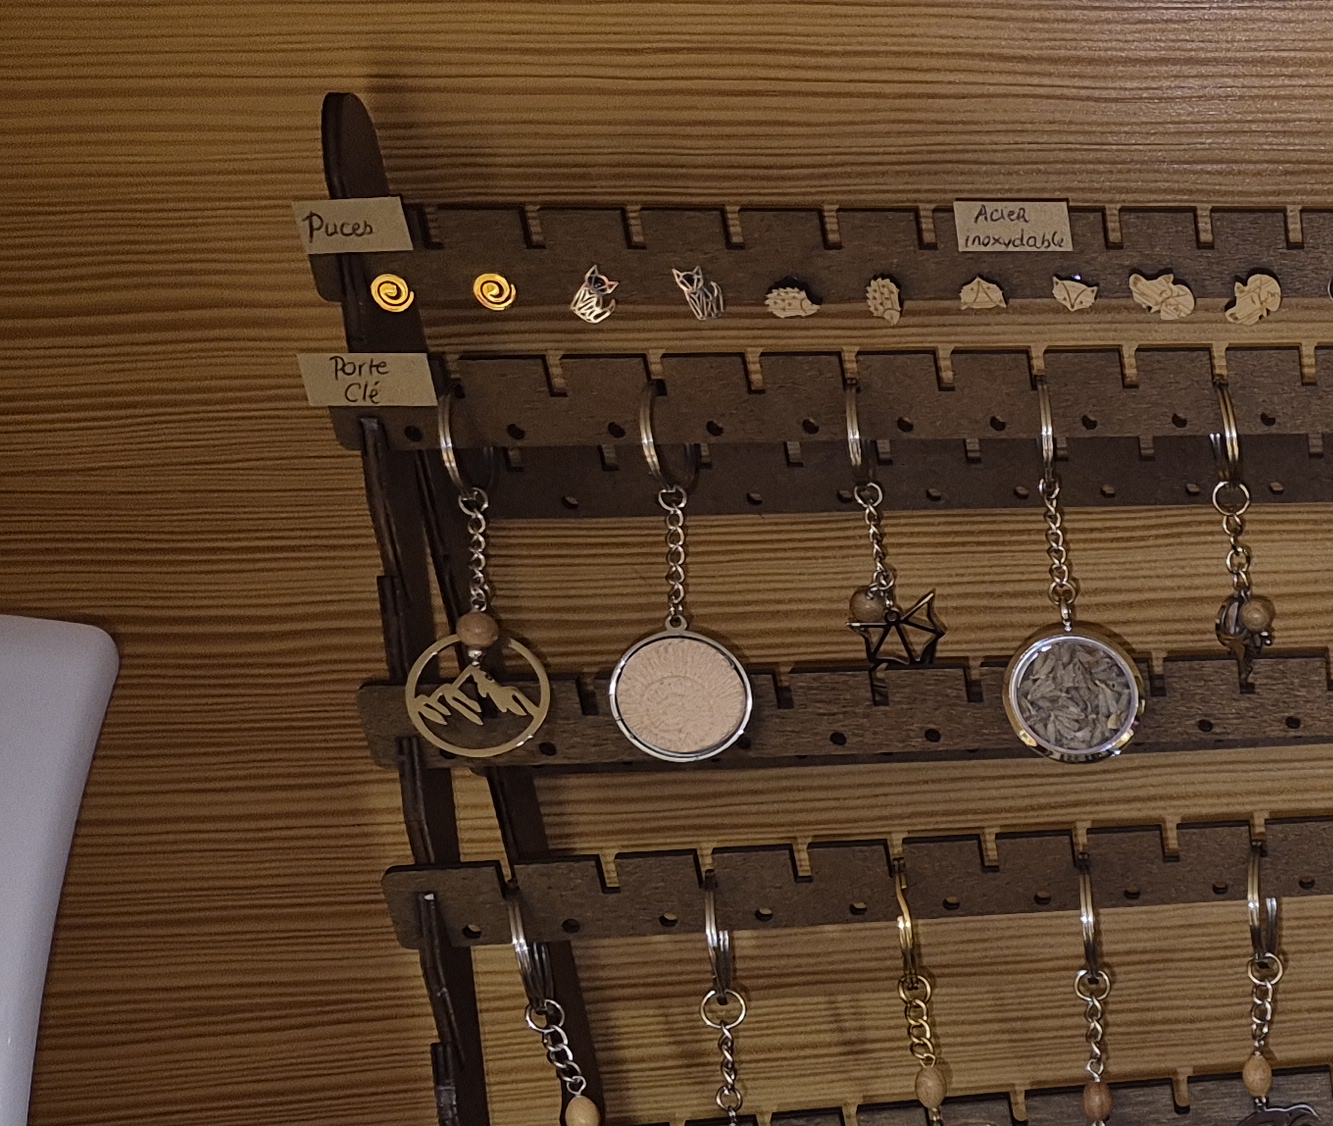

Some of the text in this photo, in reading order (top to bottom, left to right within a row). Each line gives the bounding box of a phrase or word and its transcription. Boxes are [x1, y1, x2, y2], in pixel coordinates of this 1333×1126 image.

[974, 204, 1030, 224] Acier
[302, 210, 374, 244] Puces
[965, 228, 1065, 250] inoxydable
[329, 355, 390, 381] Porte
[344, 381, 380, 405] Clé
